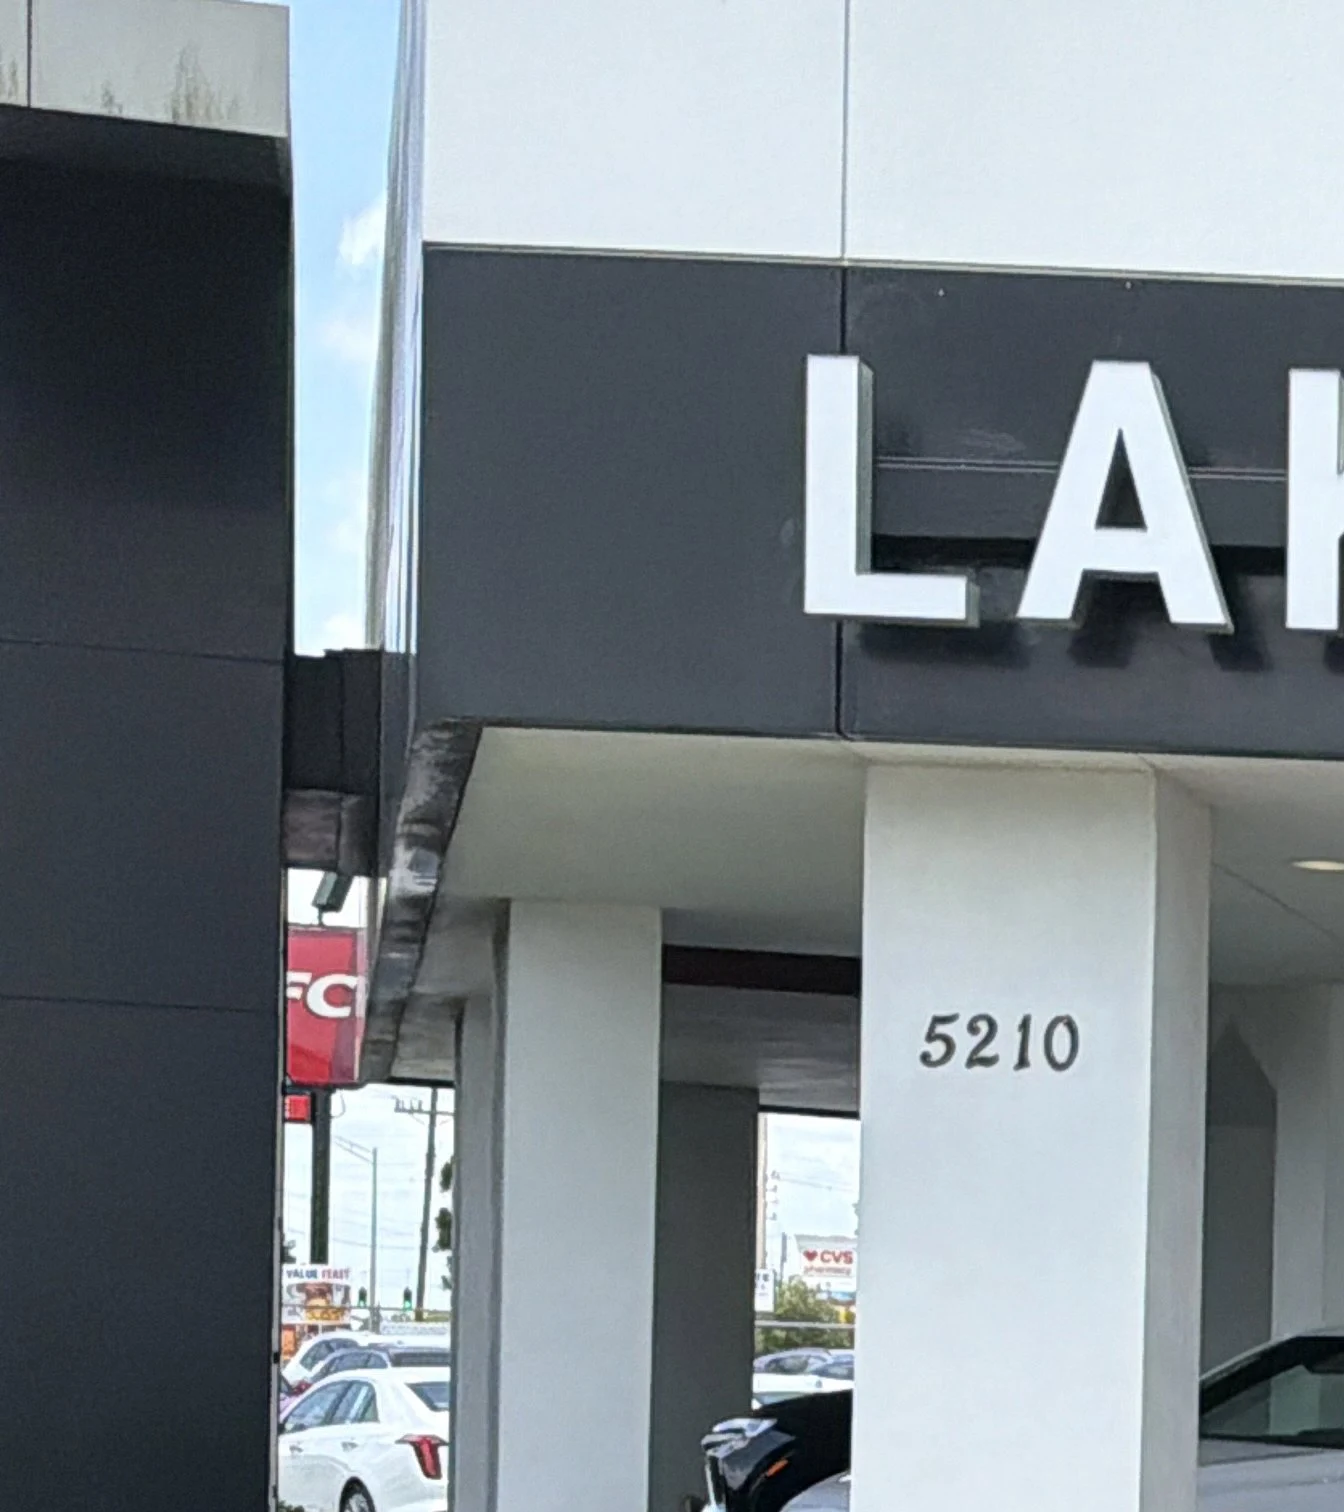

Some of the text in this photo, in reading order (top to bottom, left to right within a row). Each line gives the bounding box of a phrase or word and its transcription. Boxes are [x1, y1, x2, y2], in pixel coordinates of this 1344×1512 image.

[286, 971, 359, 1018] FC
[919, 1013, 1079, 1072] 5210
[821, 1250, 853, 1264] CVS
